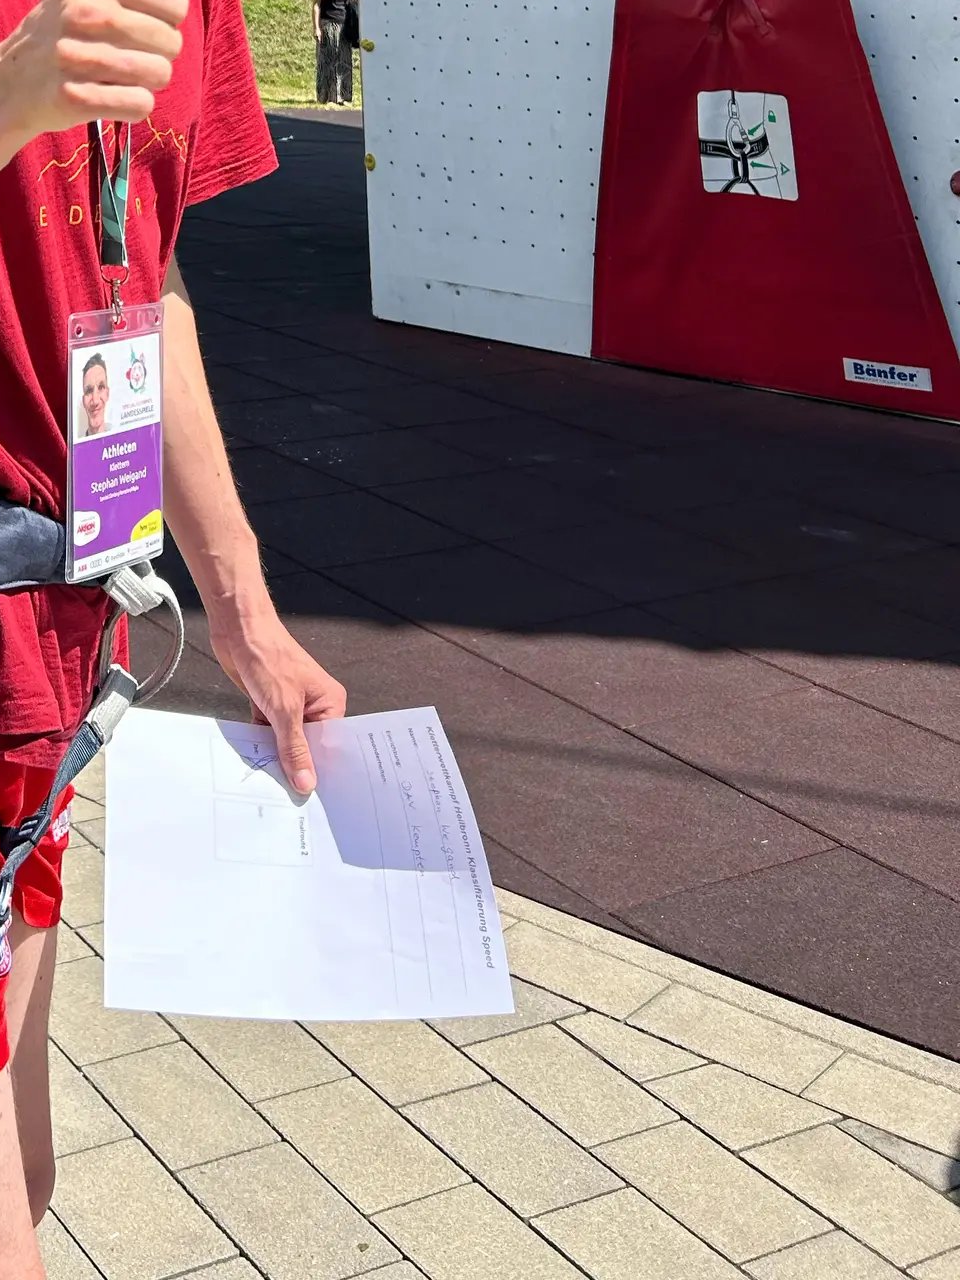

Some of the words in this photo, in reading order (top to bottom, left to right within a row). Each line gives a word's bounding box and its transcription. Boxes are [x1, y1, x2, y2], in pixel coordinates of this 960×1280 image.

[853, 361, 918, 382] Bänfer
[120, 404, 154, 420] LANDESSPIELE
[102, 442, 137, 460] Athleten
[91, 477, 119, 494] Stephan
[119, 466, 147, 484] Weigand
[298, 816, 306, 850] Finalroute
[426, 725, 460, 804] Kletterwettkampf
[454, 805, 471, 853] Heilbronn
[468, 856, 488, 933] Klassifizierung
[482, 936, 495, 969] Speed
